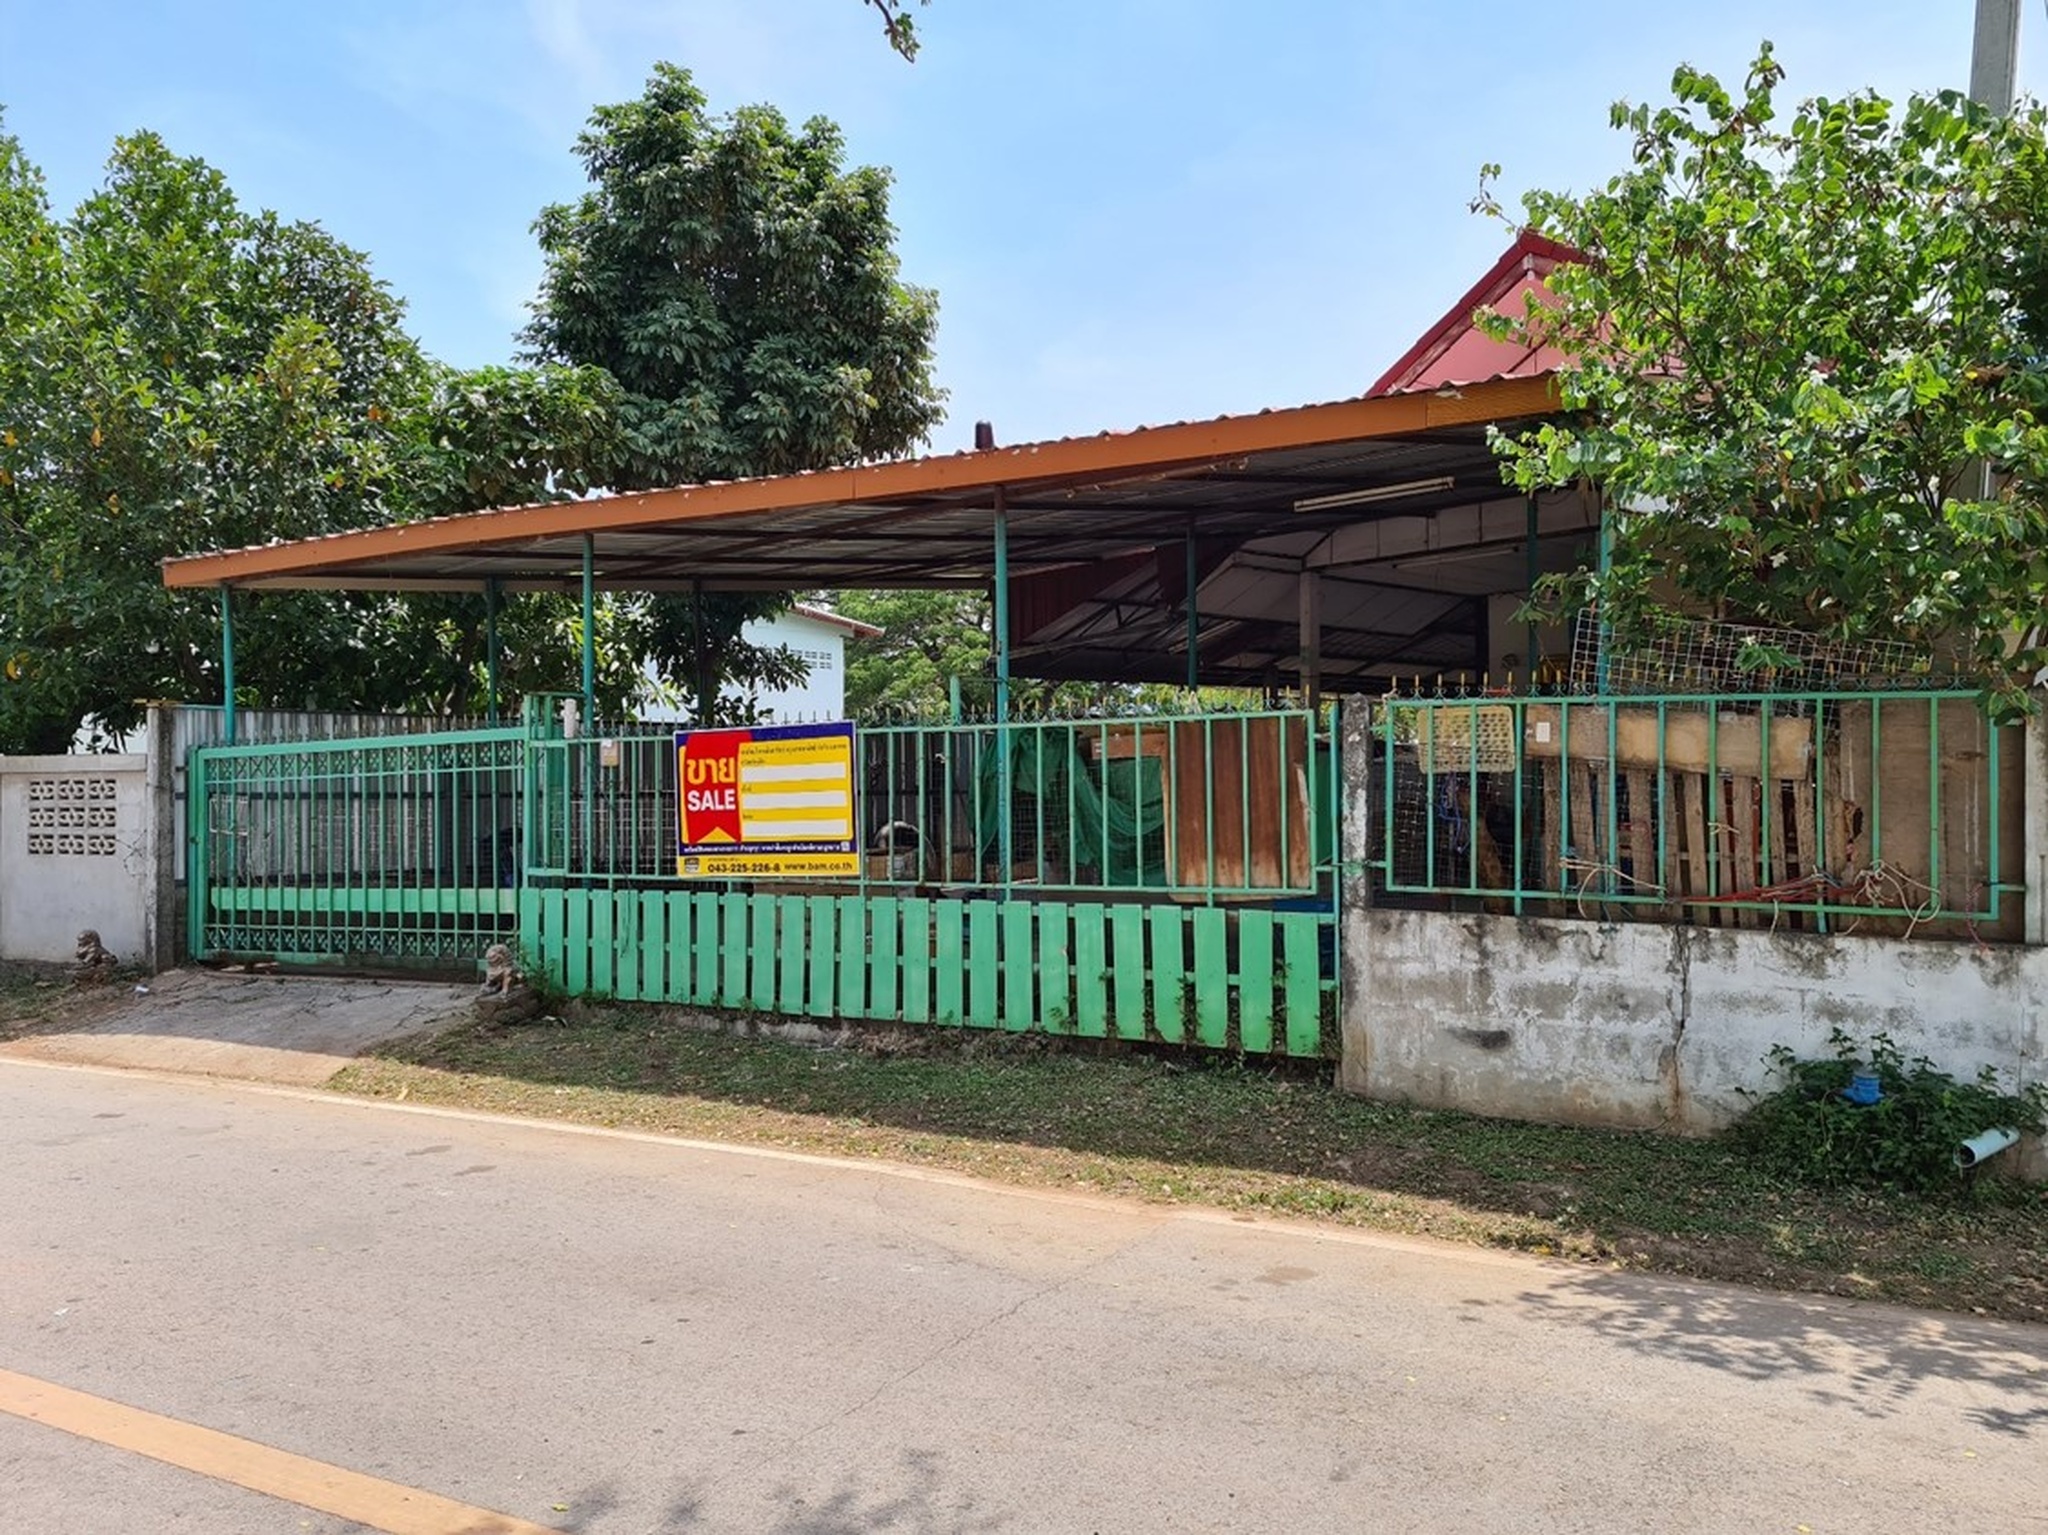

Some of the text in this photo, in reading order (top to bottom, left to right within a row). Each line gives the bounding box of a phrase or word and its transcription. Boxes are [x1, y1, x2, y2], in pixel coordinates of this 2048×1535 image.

[687, 757, 735, 785] ขาย
[687, 789, 736, 812] SALE
[707, 862, 781, 873] 043-225-226-8
[784, 862, 853, 871] www.bam.co.th
